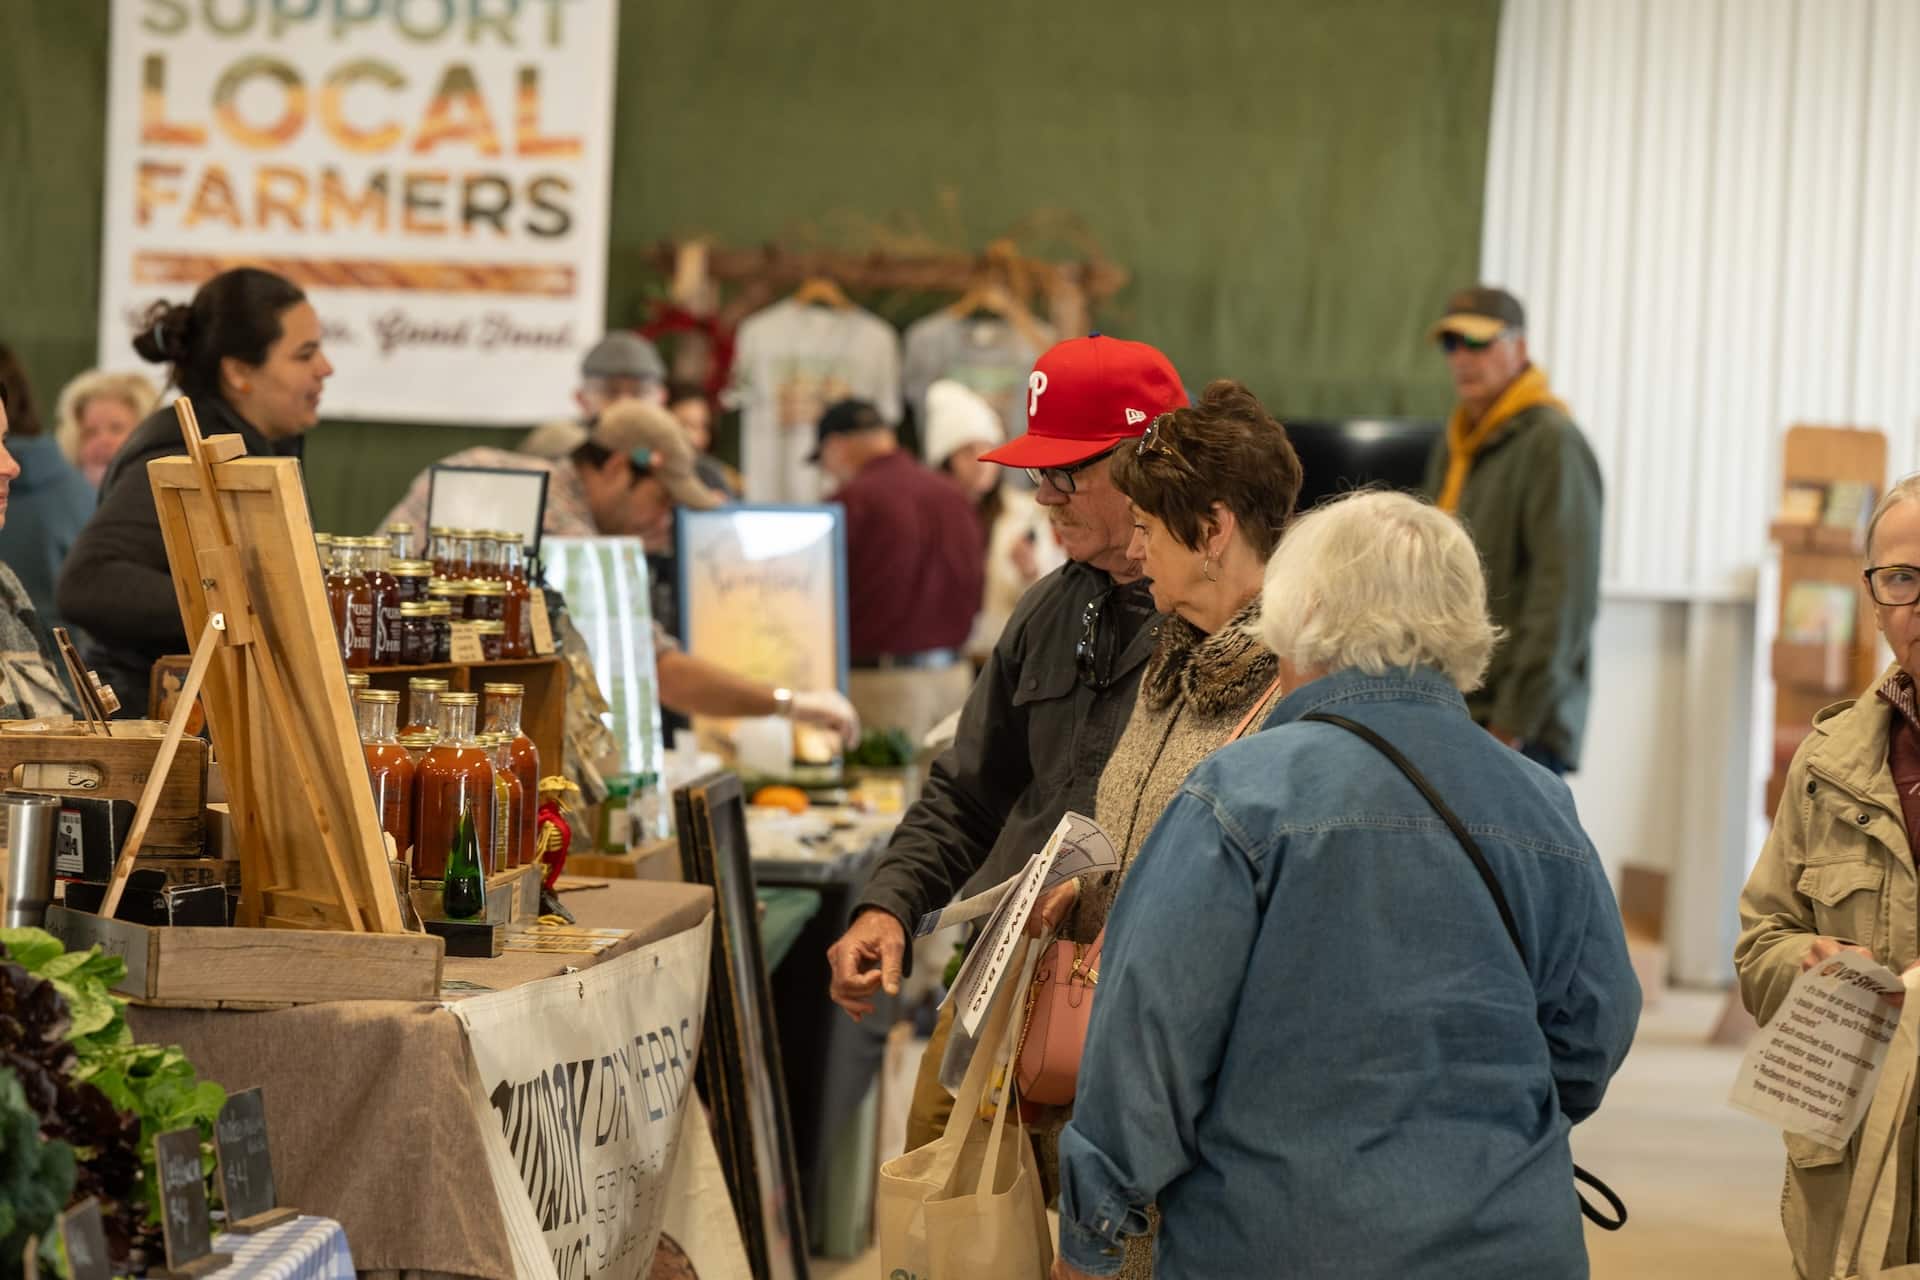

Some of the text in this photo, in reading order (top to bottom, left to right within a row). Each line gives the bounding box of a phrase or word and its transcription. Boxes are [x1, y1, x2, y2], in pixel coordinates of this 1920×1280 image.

[138, 0, 570, 48] SUPPORT
[140, 53, 584, 158] LOCAL
[135, 160, 575, 240] FARMERS
[1029, 370, 1049, 416] P
[1030, 859, 1047, 893] VIP
[996, 898, 1029, 963] SWAG
[972, 968, 997, 1013] BAG
[1833, 966, 1861, 982] VIP
[1783, 1043, 1807, 1057] vendor
[1801, 1085, 1829, 1101] voucher
[1803, 1070, 1827, 1084] vendor
